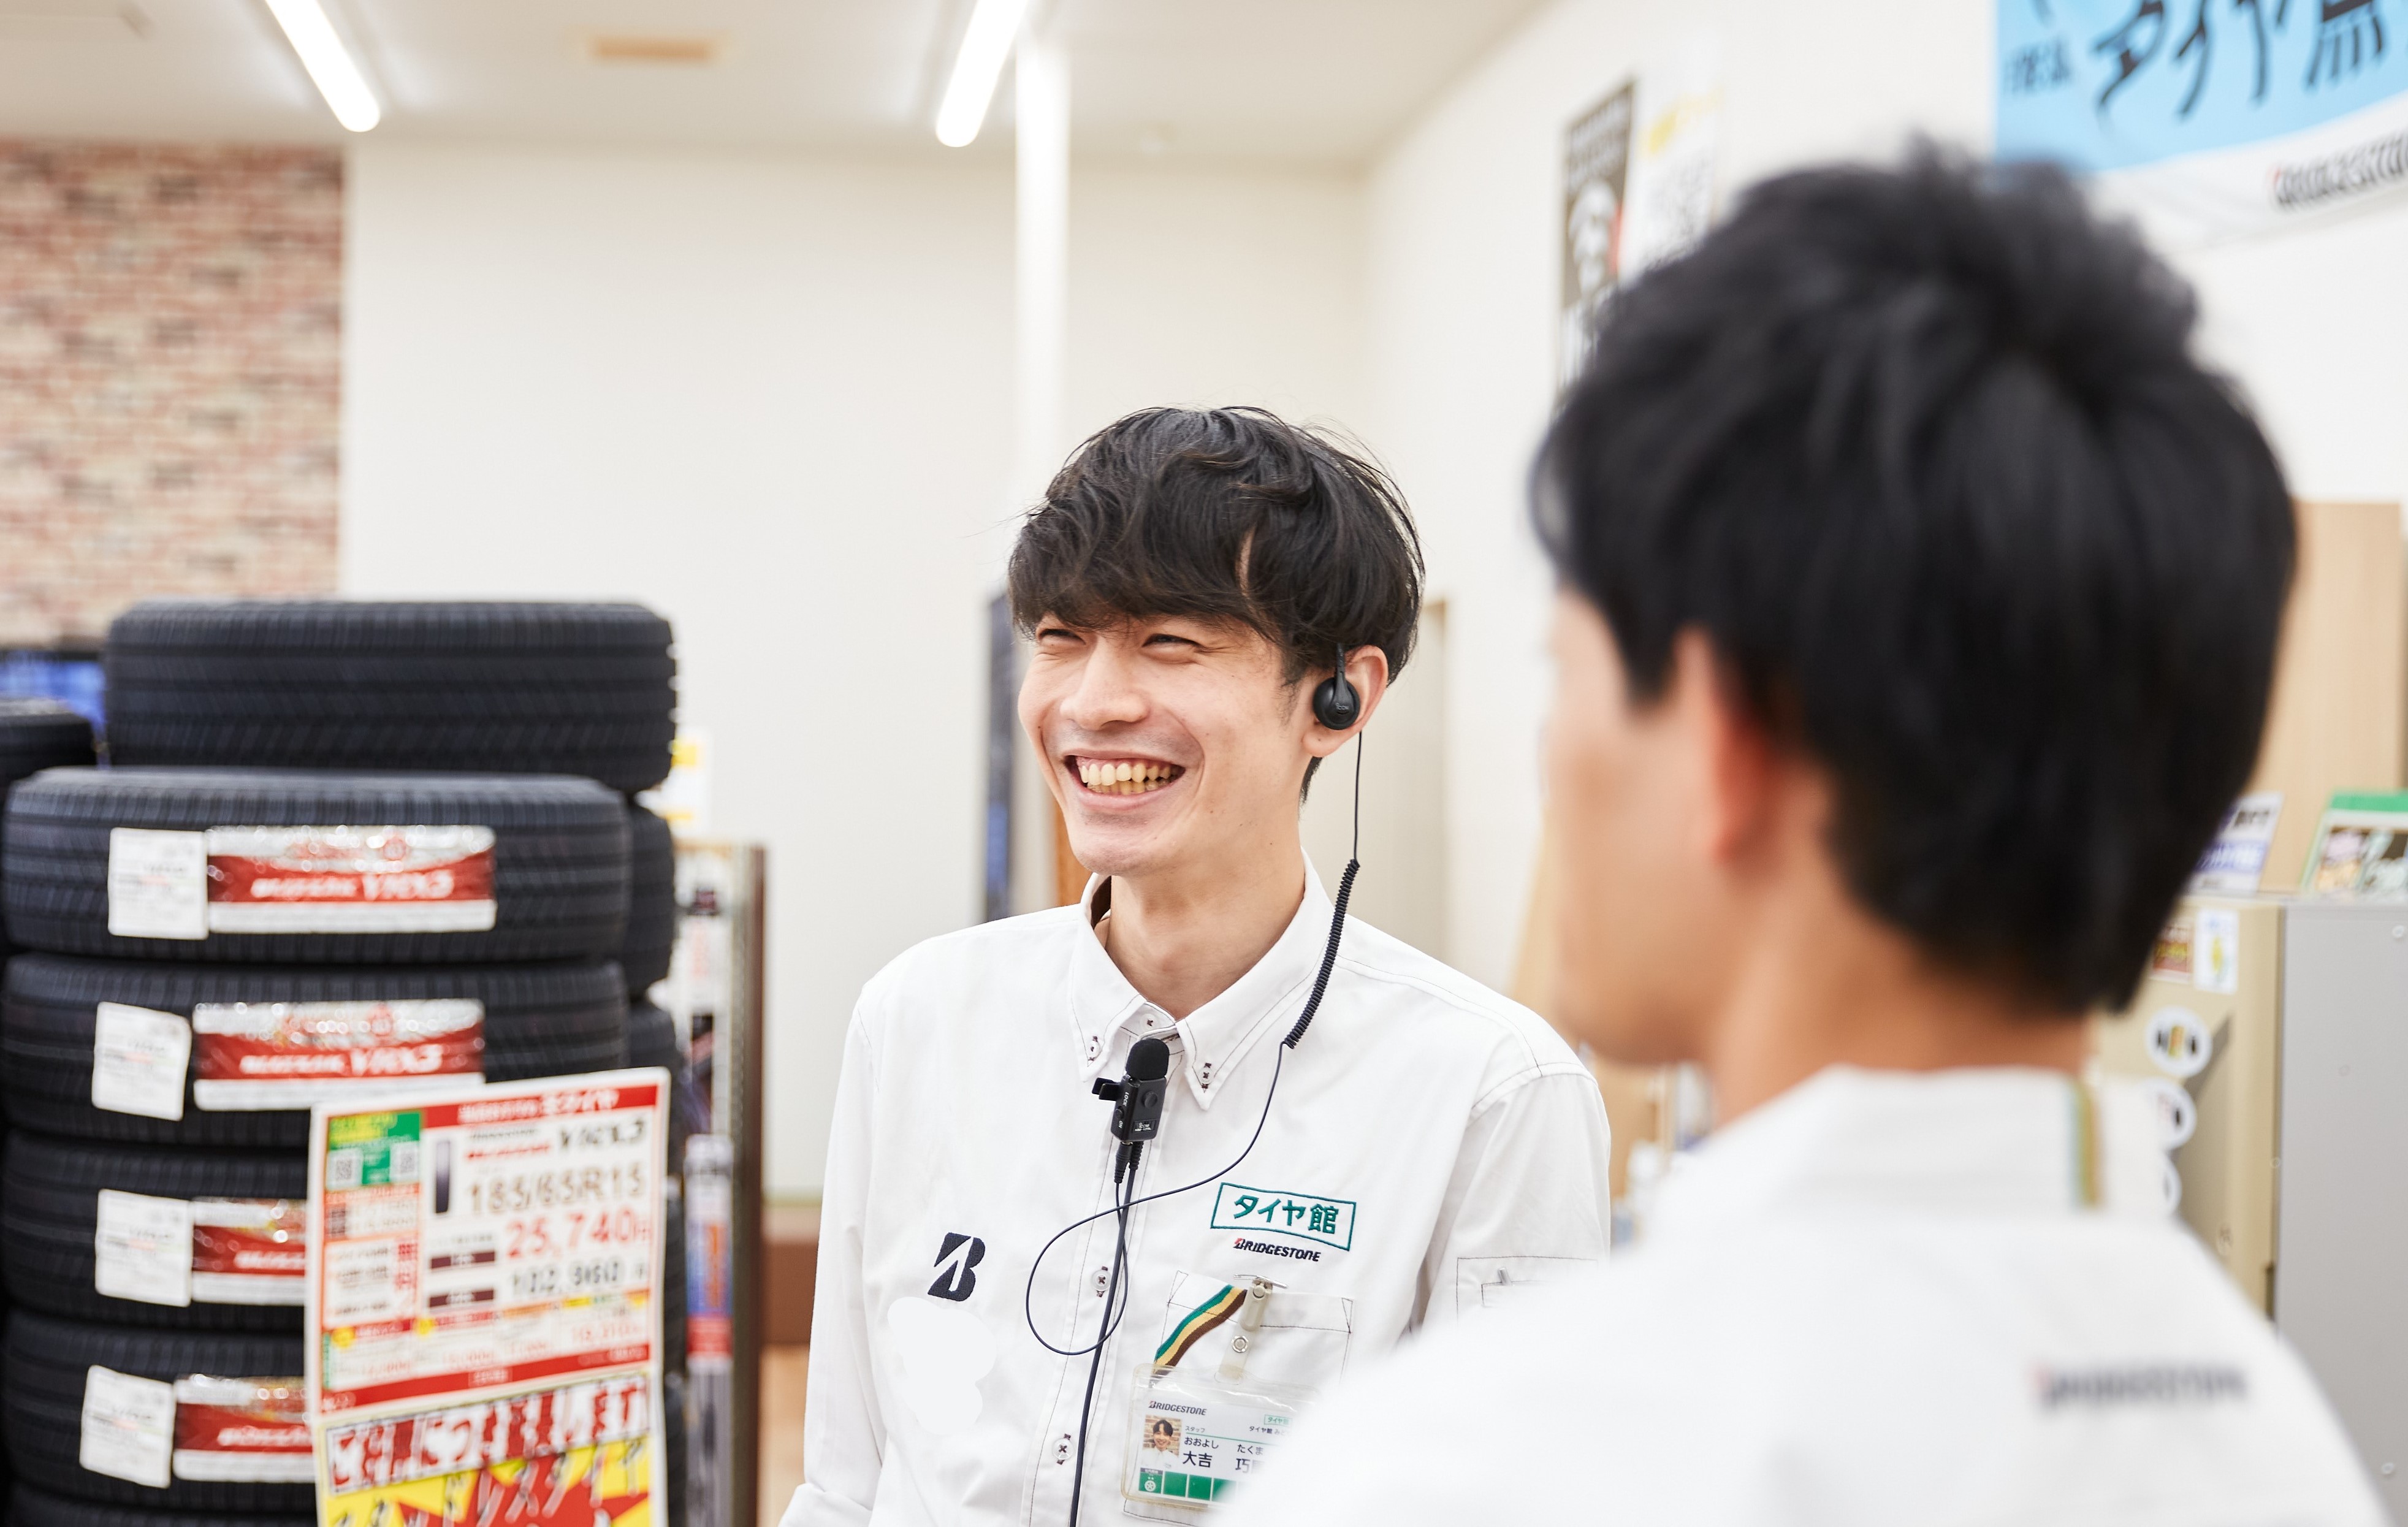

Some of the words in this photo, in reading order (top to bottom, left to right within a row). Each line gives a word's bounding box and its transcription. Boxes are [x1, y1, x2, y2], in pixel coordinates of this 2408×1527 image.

[1118, 1120, 1123, 1129] ON
[1233, 1195, 1339, 1235] タイヤ館
[1233, 1238, 1321, 1262] BRIDGESTONE
[1148, 1401, 1207, 1415] BRIDGESTONE
[1184, 1437, 1219, 1449] おおよし
[1183, 1450, 1213, 1468] 大吉
[1235, 1458, 1265, 1474] 巧
